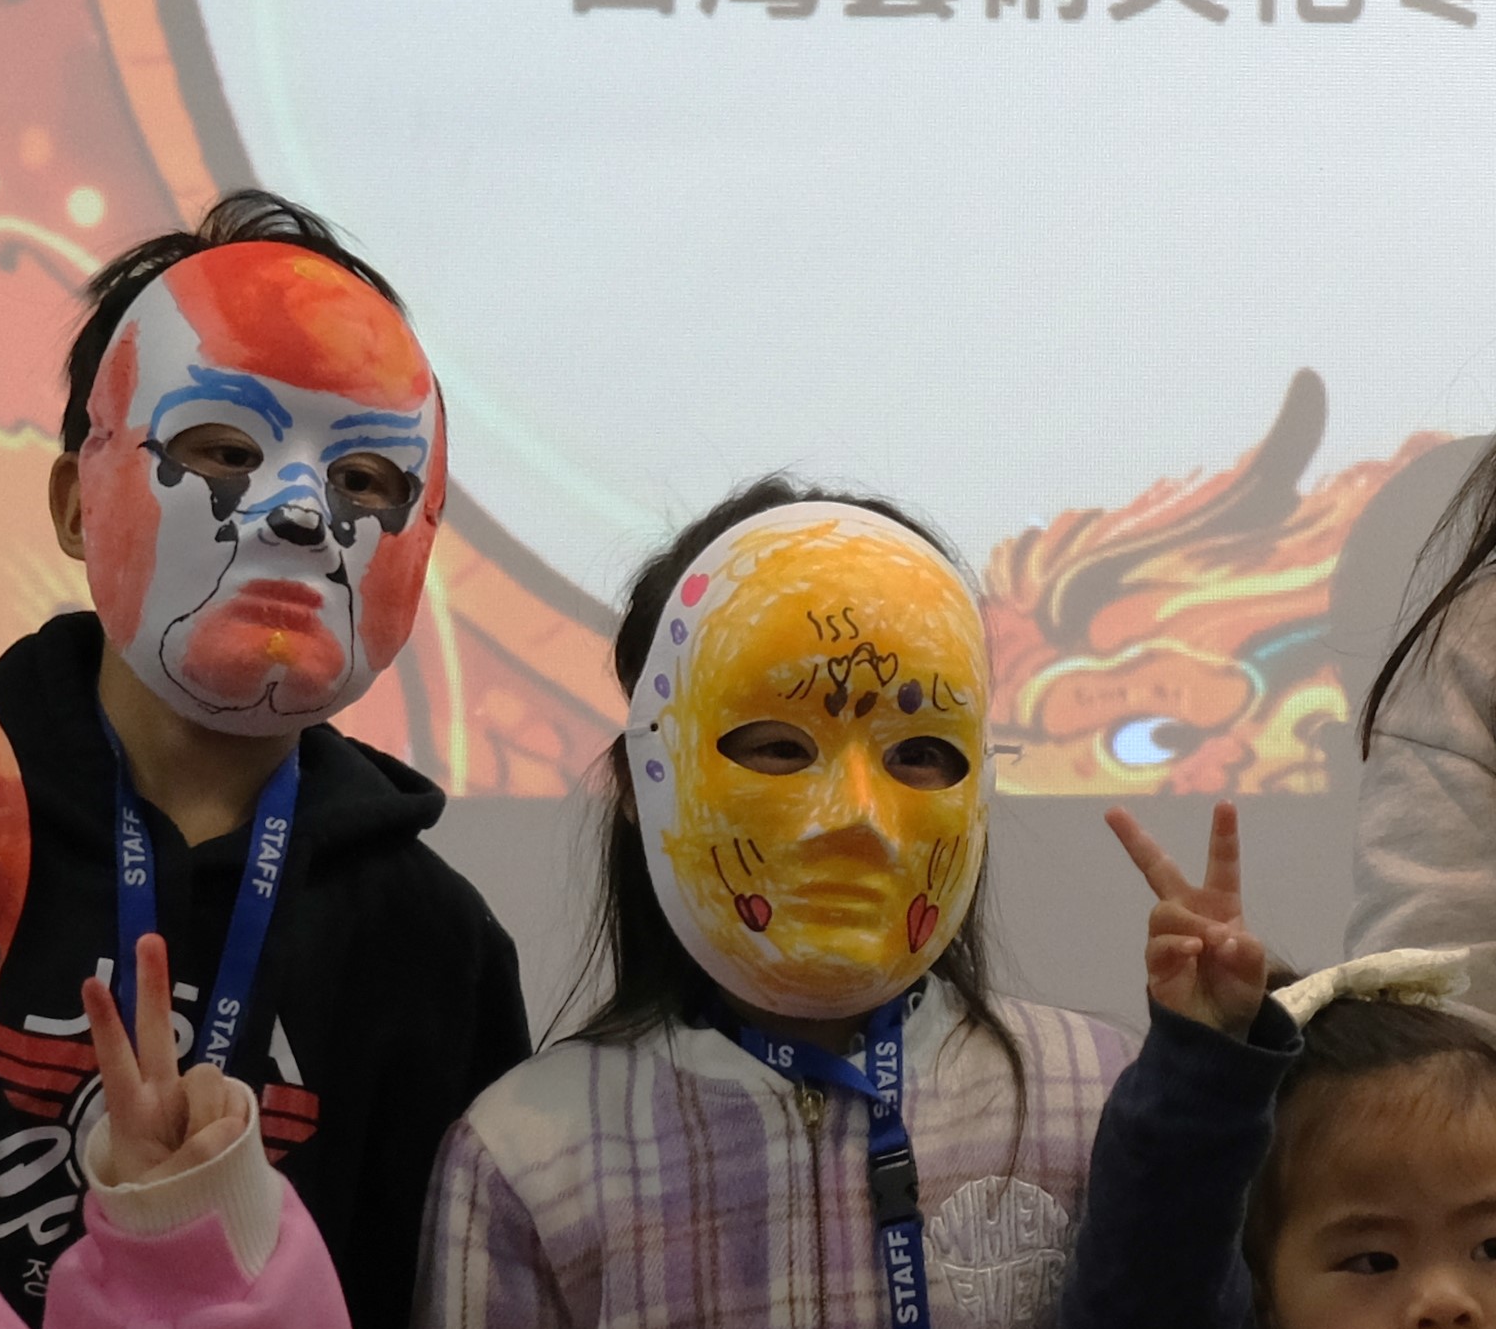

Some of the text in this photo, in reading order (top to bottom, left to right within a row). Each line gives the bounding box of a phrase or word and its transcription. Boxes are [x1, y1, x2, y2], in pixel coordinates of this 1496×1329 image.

[123, 807, 147, 887] STAFF
[251, 816, 288, 899] STAFF
[205, 997, 241, 1069] STAF
[887, 1230, 919, 1324] STAFF
